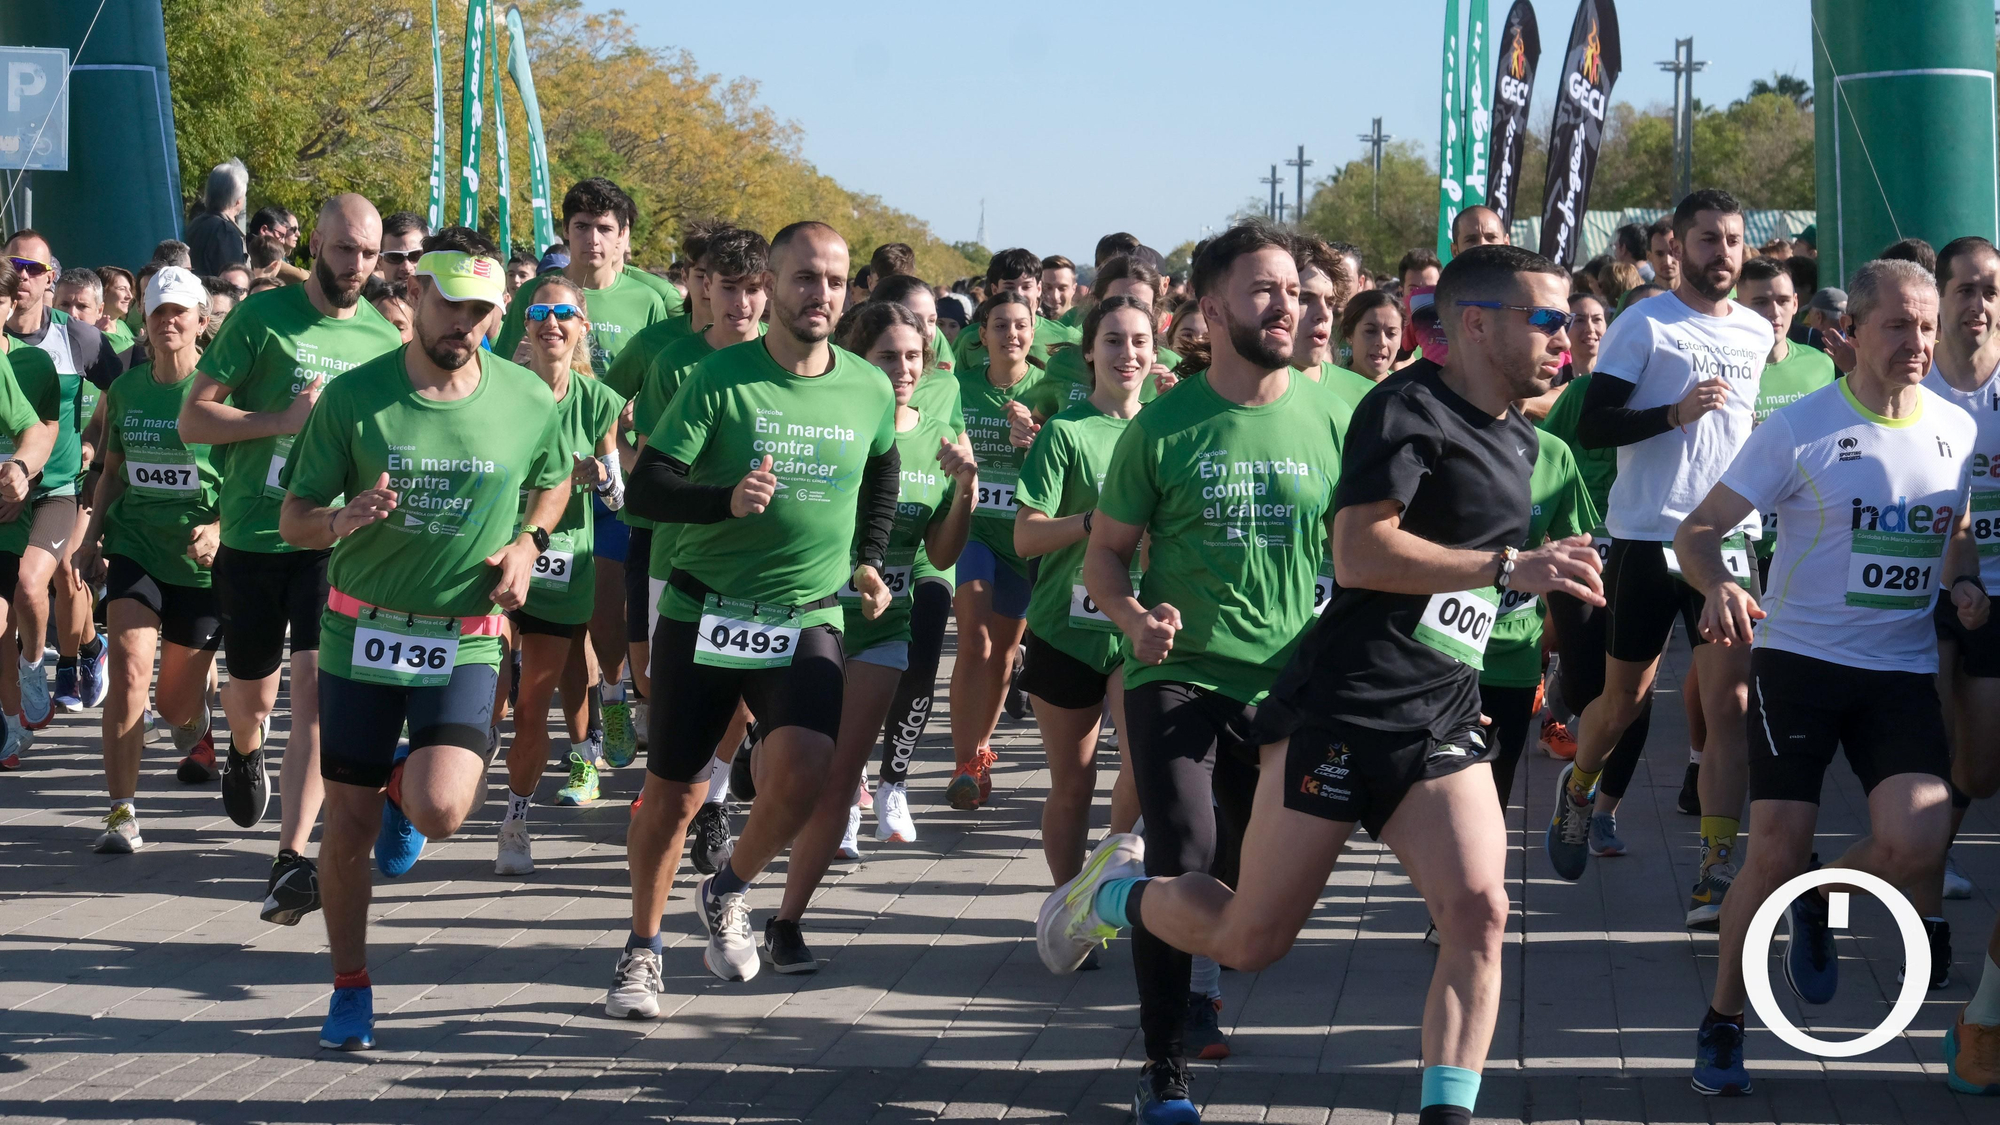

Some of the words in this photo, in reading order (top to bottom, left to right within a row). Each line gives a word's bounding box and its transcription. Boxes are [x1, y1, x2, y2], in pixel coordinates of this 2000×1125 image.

[8, 62, 46, 111] P
[1569, 72, 1605, 121] GECI
[1555, 222, 1569, 264] orte
[589, 321, 621, 334] archa
[295, 348, 317, 364] En
[320, 355, 361, 371] marc
[590, 348, 610, 358] cer
[1722, 346, 1758, 360] Contigo
[294, 366, 337, 384] contr
[1692, 352, 1751, 380] Mamá
[1069, 389, 1087, 401] En
[1754, 394, 1762, 406] n
[756, 408, 783, 416] Córdoba
[963, 413, 976, 425] En
[980, 416, 1012, 428] marc
[123, 415, 139, 427] En
[143, 418, 180, 430] marc
[755, 416, 780, 435] En
[787, 423, 855, 441] marcha
[123, 431, 161, 442] contra
[753, 439, 814, 456] contra
[973, 441, 1018, 454] cáncer
[1198, 449, 1228, 459] Córdoba
[388, 454, 413, 471] En
[421, 456, 495, 473] marcha
[750, 458, 760, 470] e
[773, 457, 838, 477] cáncer
[1199, 460, 1227, 479] En
[1234, 457, 1309, 476] marcha
[136, 467, 192, 486] 0487
[389, 474, 450, 491] contra
[899, 469, 936, 485] rcha
[978, 487, 1015, 507] 317
[1202, 479, 1267, 500] contra
[407, 492, 473, 510] cáncer
[895, 502, 923, 517] cer
[1203, 502, 1221, 519] el
[1227, 500, 1295, 518] cáncer
[1851, 496, 1953, 534] indea
[535, 555, 566, 576] 93
[1862, 563, 1932, 590] 0281
[393, 614, 409, 622] March
[711, 625, 790, 654] 0493
[365, 638, 447, 669] 0136
[891, 697, 930, 772] adidas
